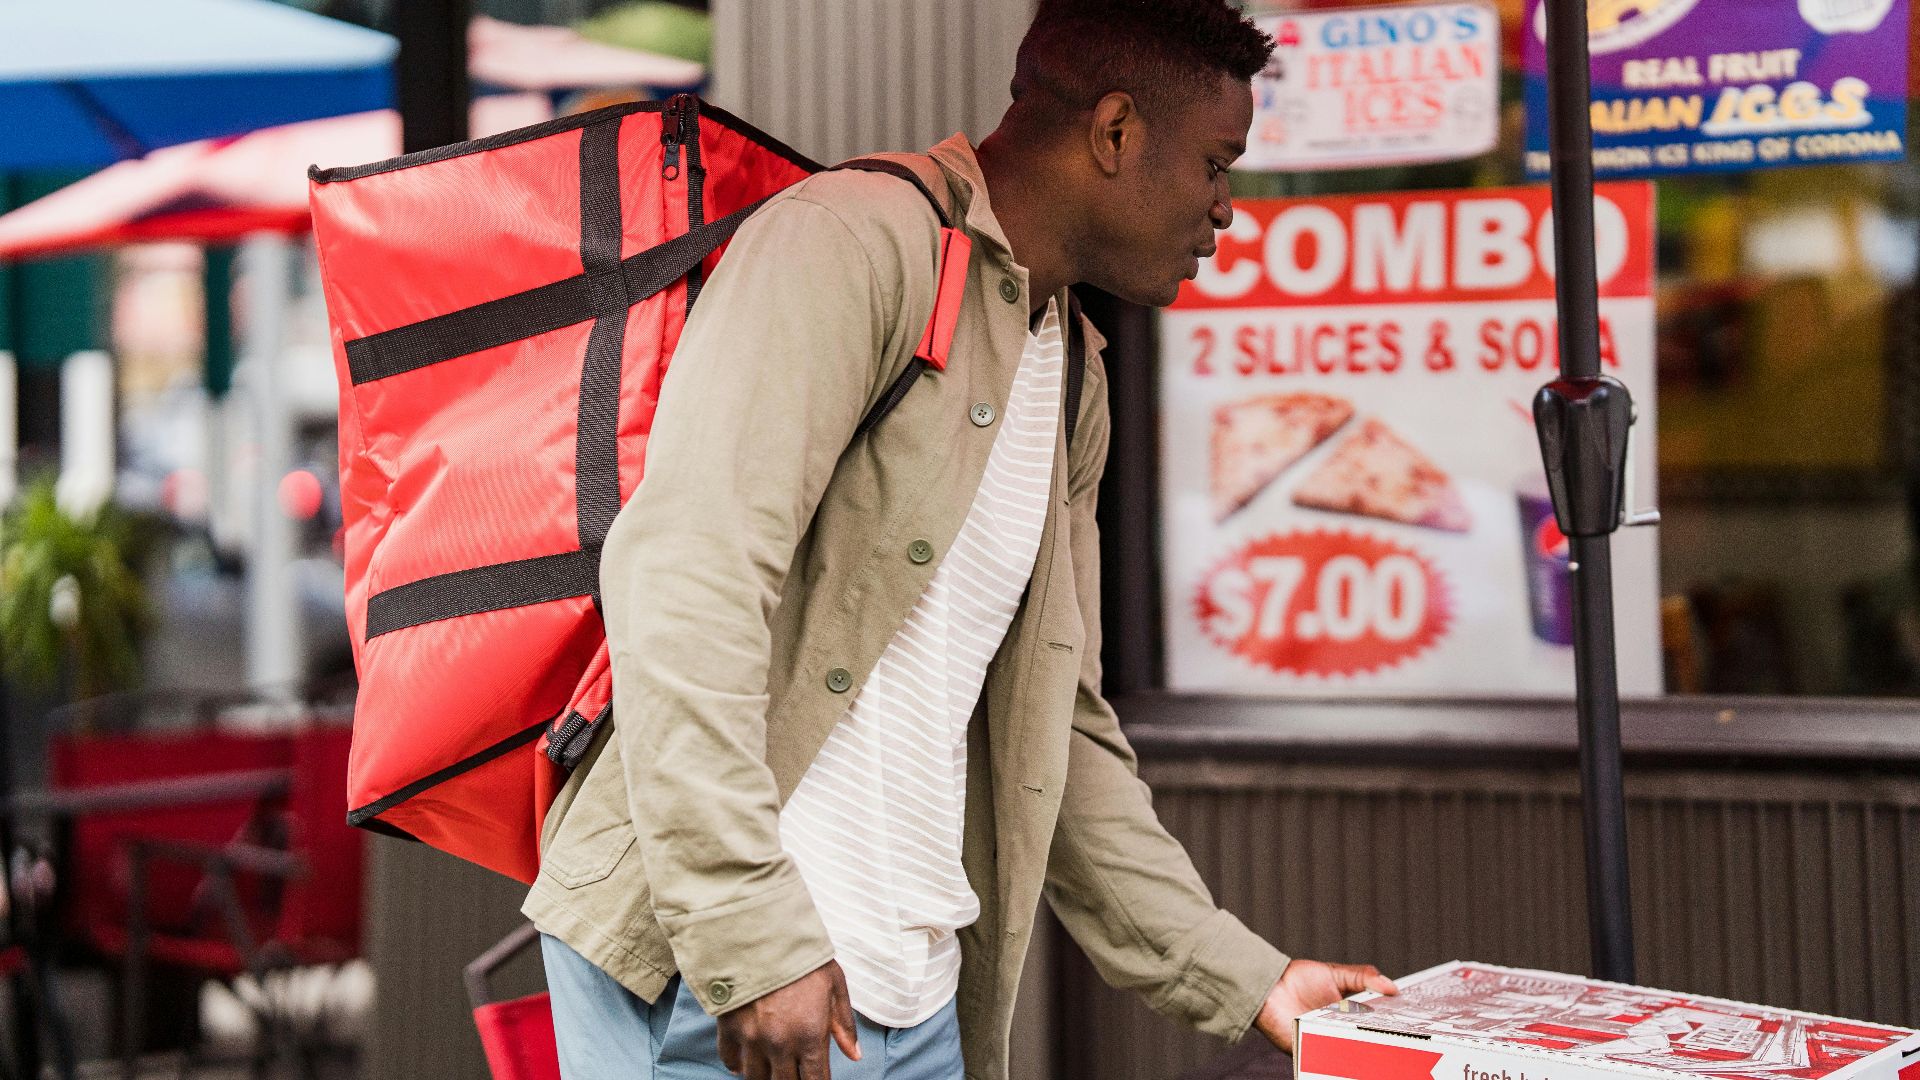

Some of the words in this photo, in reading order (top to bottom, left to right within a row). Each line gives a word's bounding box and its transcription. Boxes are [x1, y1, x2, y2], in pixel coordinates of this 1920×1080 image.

[1306, 44, 1485, 90] ITALIAN
[1623, 57, 1703, 90] REAL
[1708, 48, 1801, 83] FRUIT
[1344, 82, 1444, 133] ICES
[1590, 95, 1703, 134] ALIAN
[1193, 193, 1629, 299] COMBO
[1191, 326, 1216, 376] 2
[1234, 320, 1403, 376] SLICES
[1423, 318, 1456, 372] &
[1478, 314, 1620, 373] SOA
[1208, 555, 1428, 643] $7.00
